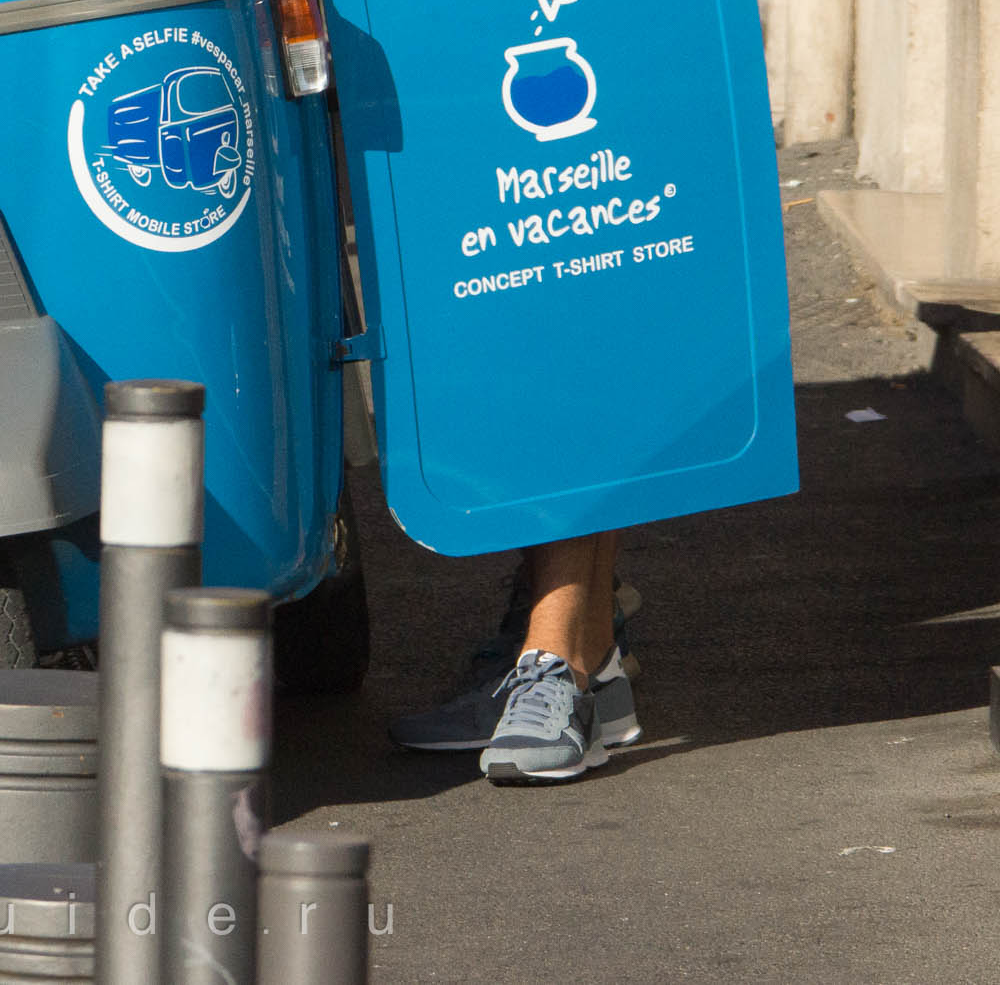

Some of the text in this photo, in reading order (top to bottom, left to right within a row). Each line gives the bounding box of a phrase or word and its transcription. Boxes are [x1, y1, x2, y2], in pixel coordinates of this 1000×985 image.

[78, 52, 120, 97] TAKE
[120, 43, 134, 60] A
[132, 27, 188, 52] SELFIE
[91, 157, 130, 213] T-SHIRT
[125, 208, 181, 236] MOBILE
[495, 148, 633, 204] Marseille
[453, 235, 695, 299] CONCEPT T-SHIRT STORE
[461, 226, 497, 257] en
